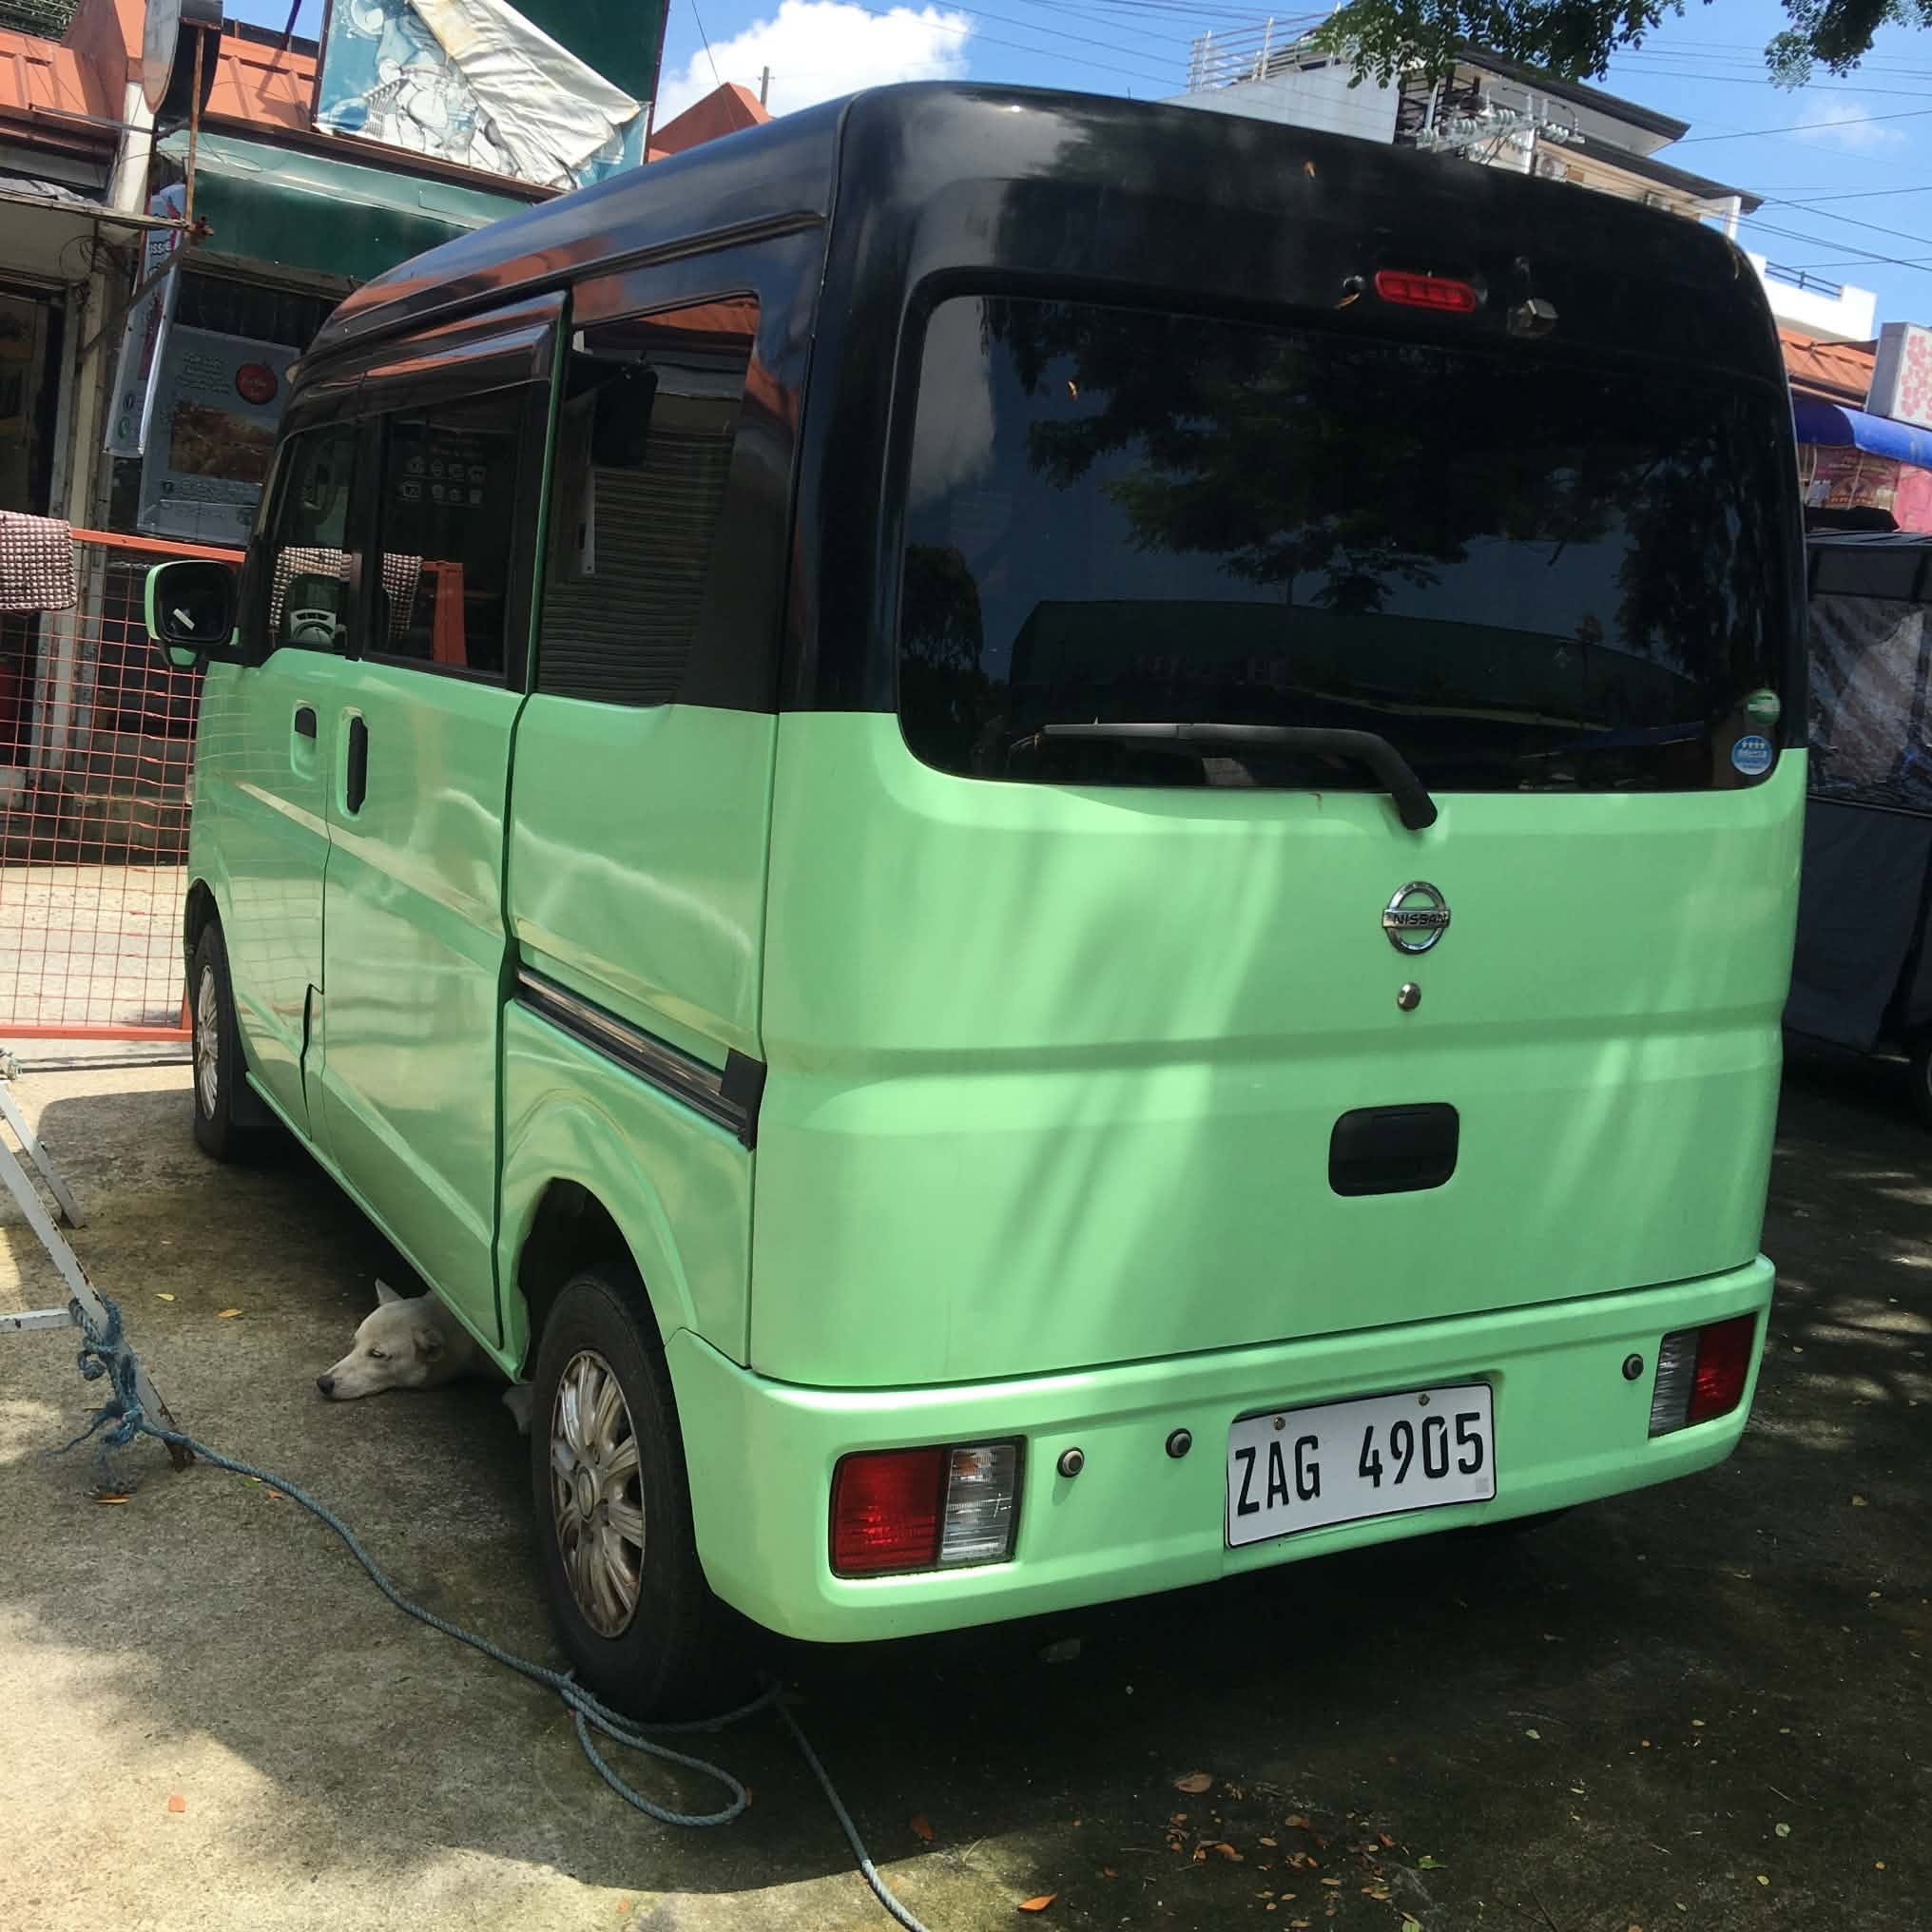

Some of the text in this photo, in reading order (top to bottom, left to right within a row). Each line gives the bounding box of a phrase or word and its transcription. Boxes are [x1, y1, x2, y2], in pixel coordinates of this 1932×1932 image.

[1393, 912, 1448, 925] NISSAN
[1235, 1411, 1484, 1517] ZAG 4905
